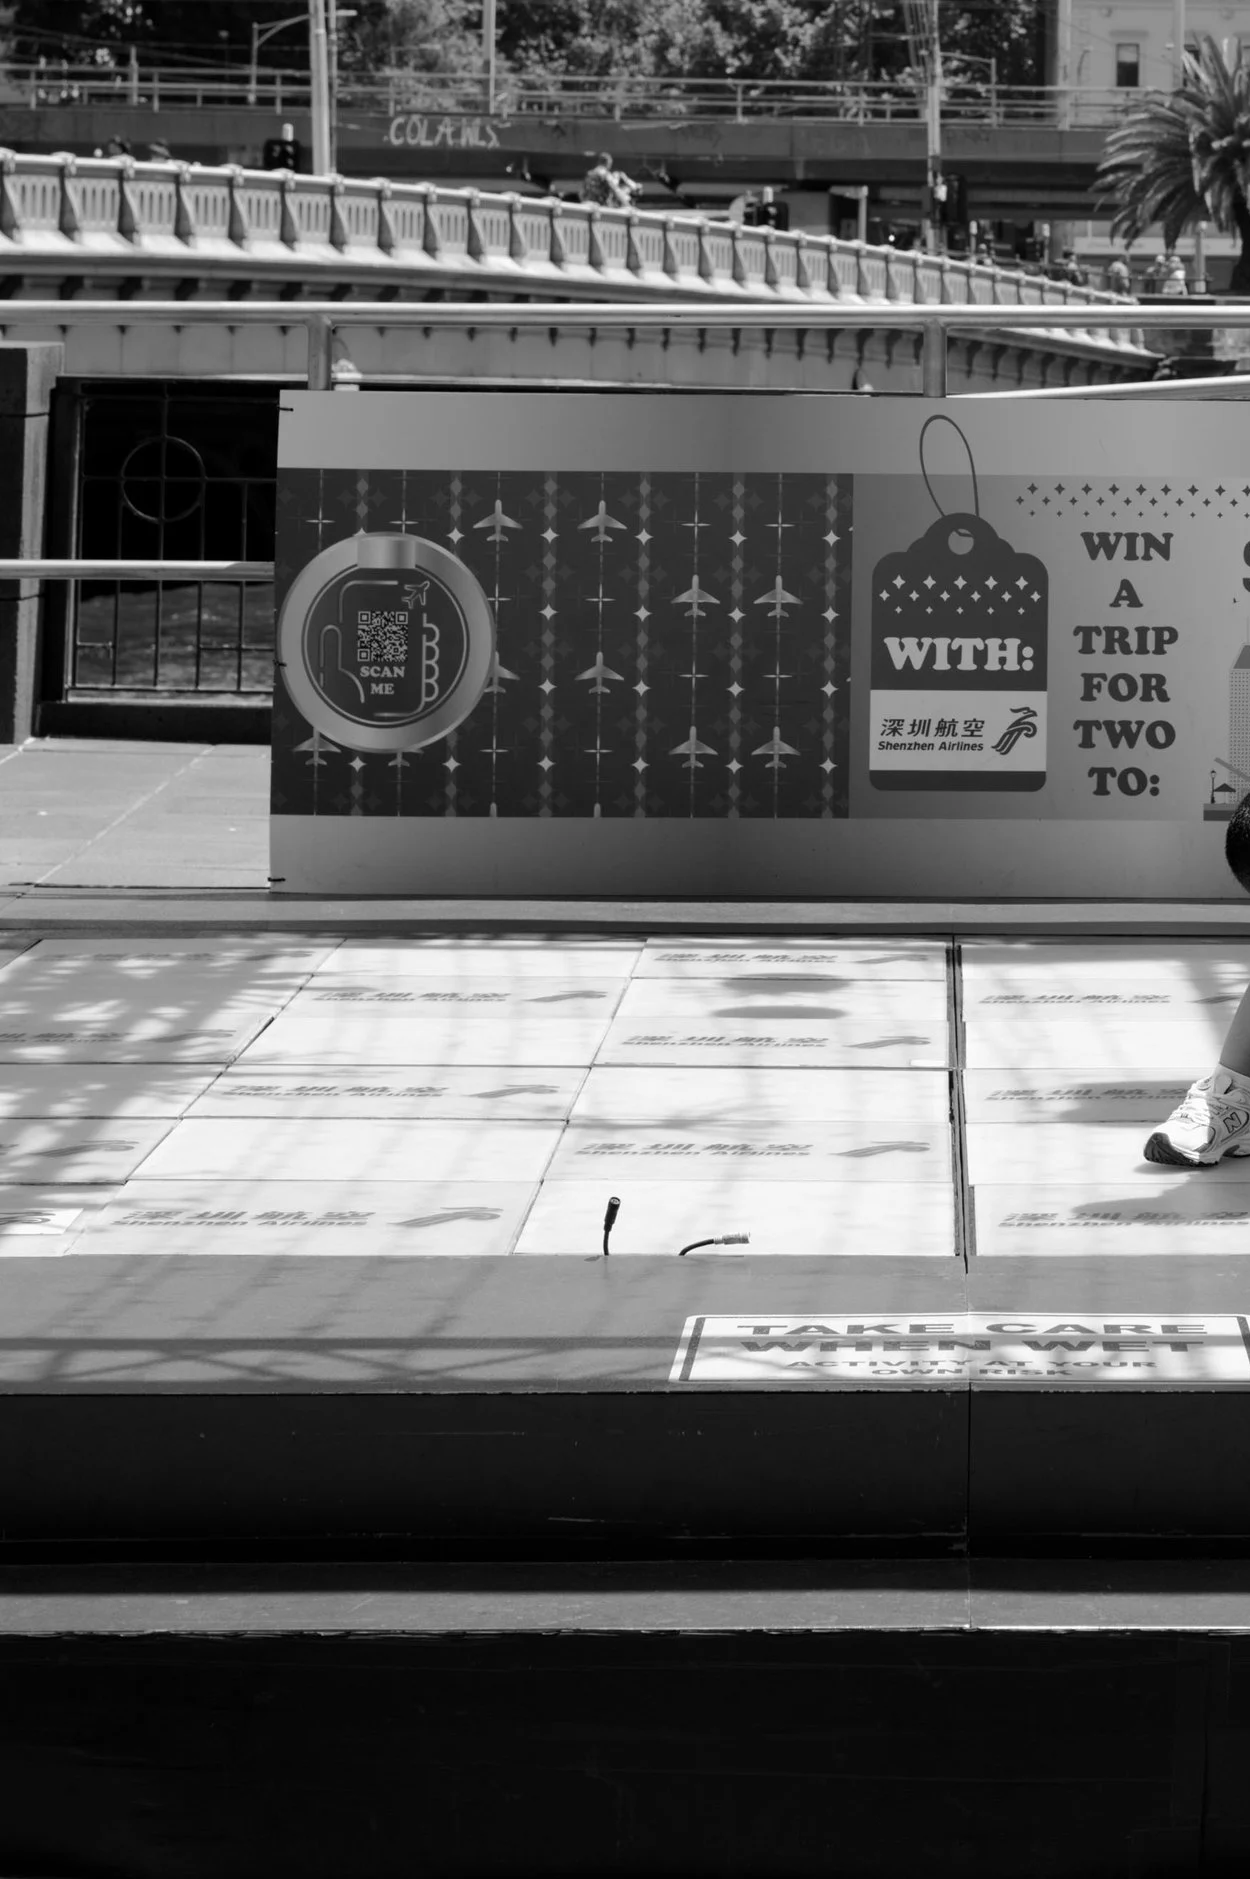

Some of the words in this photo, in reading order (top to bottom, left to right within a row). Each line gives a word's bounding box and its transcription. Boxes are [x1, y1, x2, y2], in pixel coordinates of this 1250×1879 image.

[1080, 531, 1174, 561] WIN
[1109, 578, 1144, 608] A
[883, 637, 1034, 671] WITH:
[1073, 625, 1179, 656] TRIP
[360, 666, 405, 678] SCAN
[370, 683, 394, 694] ME
[1080, 672, 1171, 703] FOR
[880, 718, 985, 738] 深圳航空
[1073, 719, 1176, 750] TWO
[878, 741, 934, 751] Shenzhen
[938, 741, 984, 751] Airlines
[1087, 766, 1160, 797] TO:
[737, 1323, 955, 1335] TAKE
[985, 1323, 1208, 1335] CARE
[740, 1340, 991, 1352] WHEN
[1021, 1340, 1204, 1352] WET
